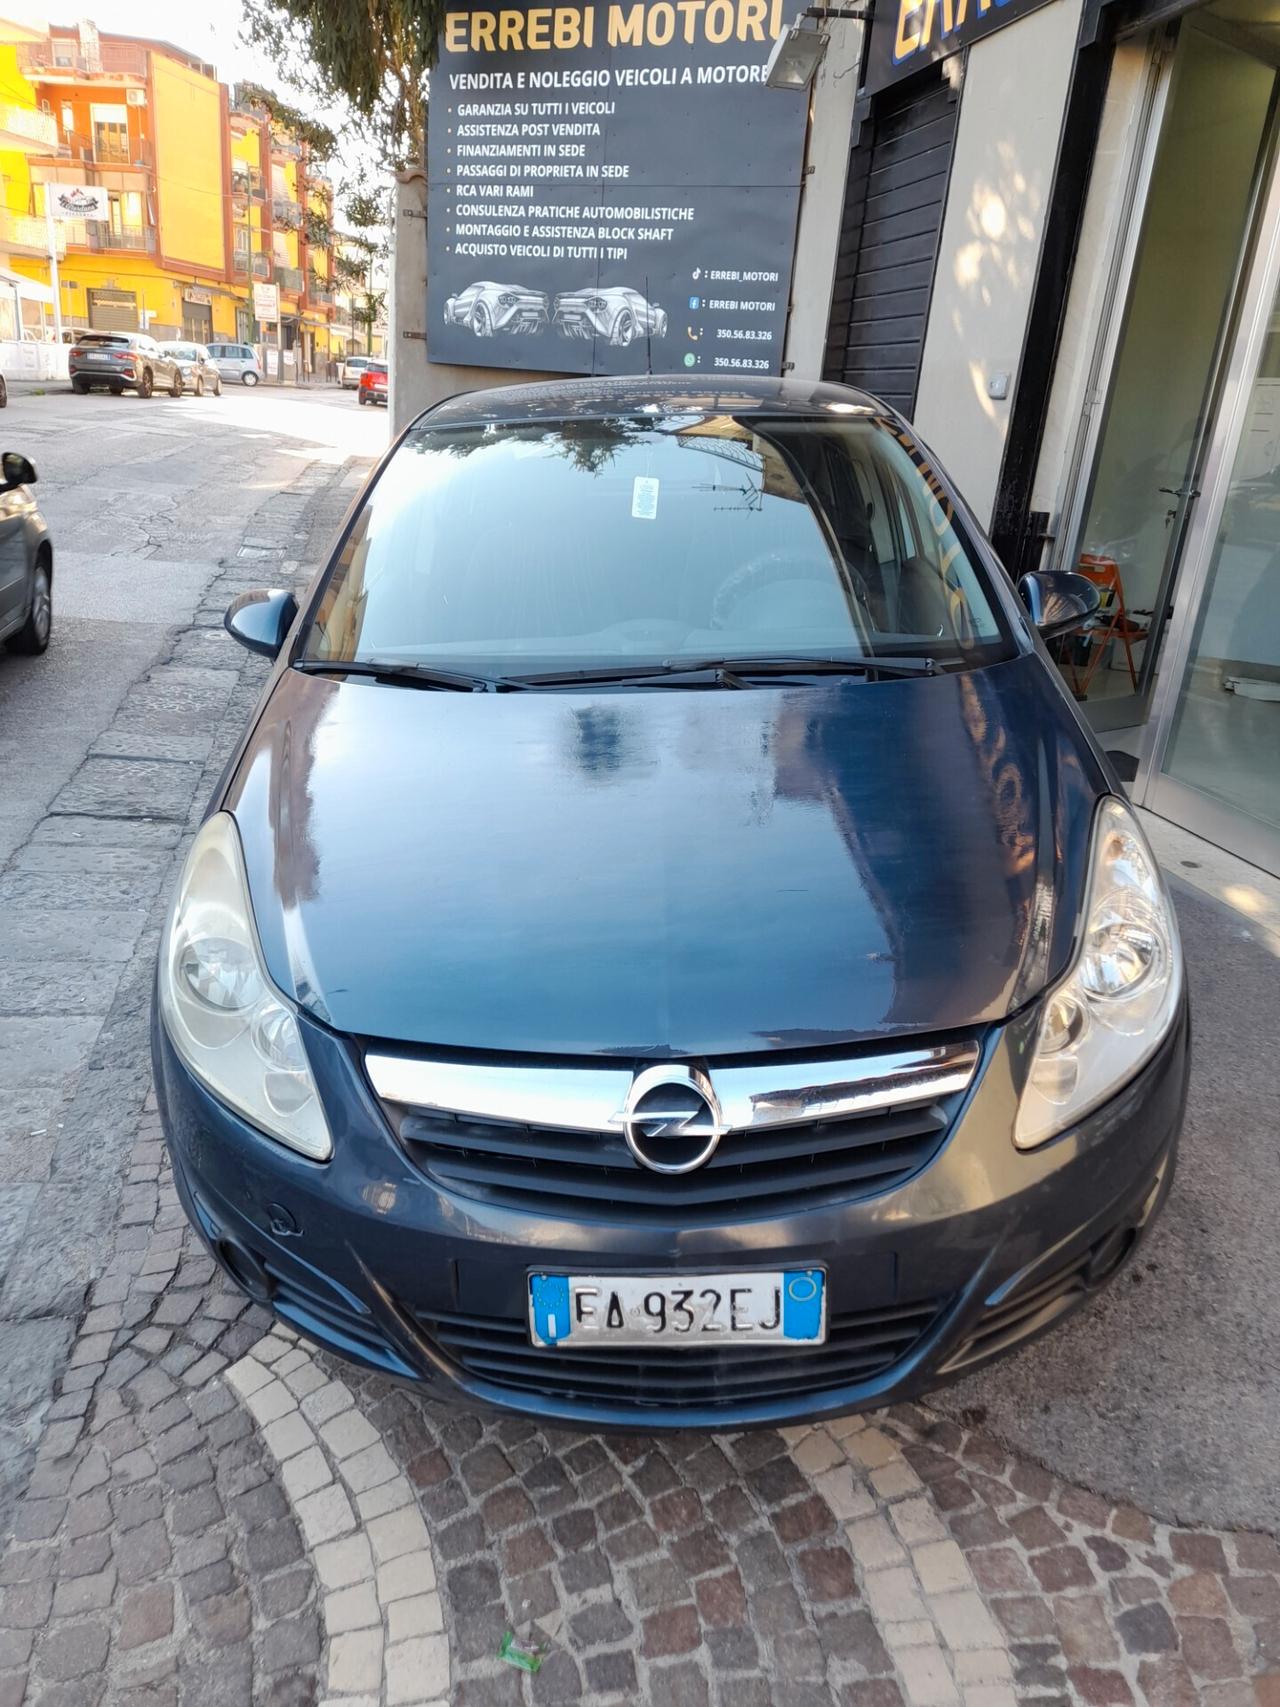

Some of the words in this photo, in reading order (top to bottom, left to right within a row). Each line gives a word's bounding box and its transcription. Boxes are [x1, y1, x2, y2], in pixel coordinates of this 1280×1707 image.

[445, 6, 595, 52] ERREBI
[607, 0, 783, 47] MOTORI
[450, 73, 513, 90] VENDITA
[517, 72, 525, 88] E
[529, 70, 610, 88] NOLEGGIO
[615, 68, 676, 86] VEICOLI
[680, 67, 693, 84] A
[457, 103, 512, 116] GARANZIA
[514, 103, 528, 115] SU
[531, 102, 562, 115] TUTTI
[565, 102, 569, 115] I
[571, 102, 615, 114] VEICOLI
[456, 124, 519, 137] ASSISTENZA
[521, 124, 549, 136] POST
[551, 123, 600, 136] VENDITA
[456, 145, 541, 157] FINANZIAMENTI
[544, 145, 556, 157] IN
[558, 145, 586, 157] SEDE
[456, 165, 507, 177] PASSAGGI
[510, 165, 521, 177] DI
[523, 165, 584, 178] PROPRIETA
[586, 166, 599, 178] IN
[601, 165, 630, 178] SEDE
[456, 185, 477, 197] RCA
[479, 185, 503, 197] VARI
[506, 185, 534, 198] RAMI
[456, 204, 526, 217] CONSULENZA
[528, 205, 580, 218] PRATICHE
[582, 206, 695, 220] AUTOMOBILISTICHE
[456, 224, 521, 237] MONTAGGIO
[523, 225, 530, 237] E
[532, 225, 595, 238] ASSISTENZA
[598, 227, 635, 239] BLOCK
[637, 228, 674, 241] SHAFT
[455, 243, 507, 256] ACQUISTO
[510, 244, 550, 257] VEICOLI
[553, 245, 564, 258] DI
[567, 246, 597, 259] TUTTI
[600, 247, 604, 259] I
[606, 247, 627, 260] TIPI
[710, 270, 779, 282] ERREBI_MOTORI
[709, 300, 738, 310] ERREBI
[740, 301, 776, 312] MOTORI
[716, 329, 773, 341] 350.56.83.326
[714, 357, 770, 370] 350.56.83.326
